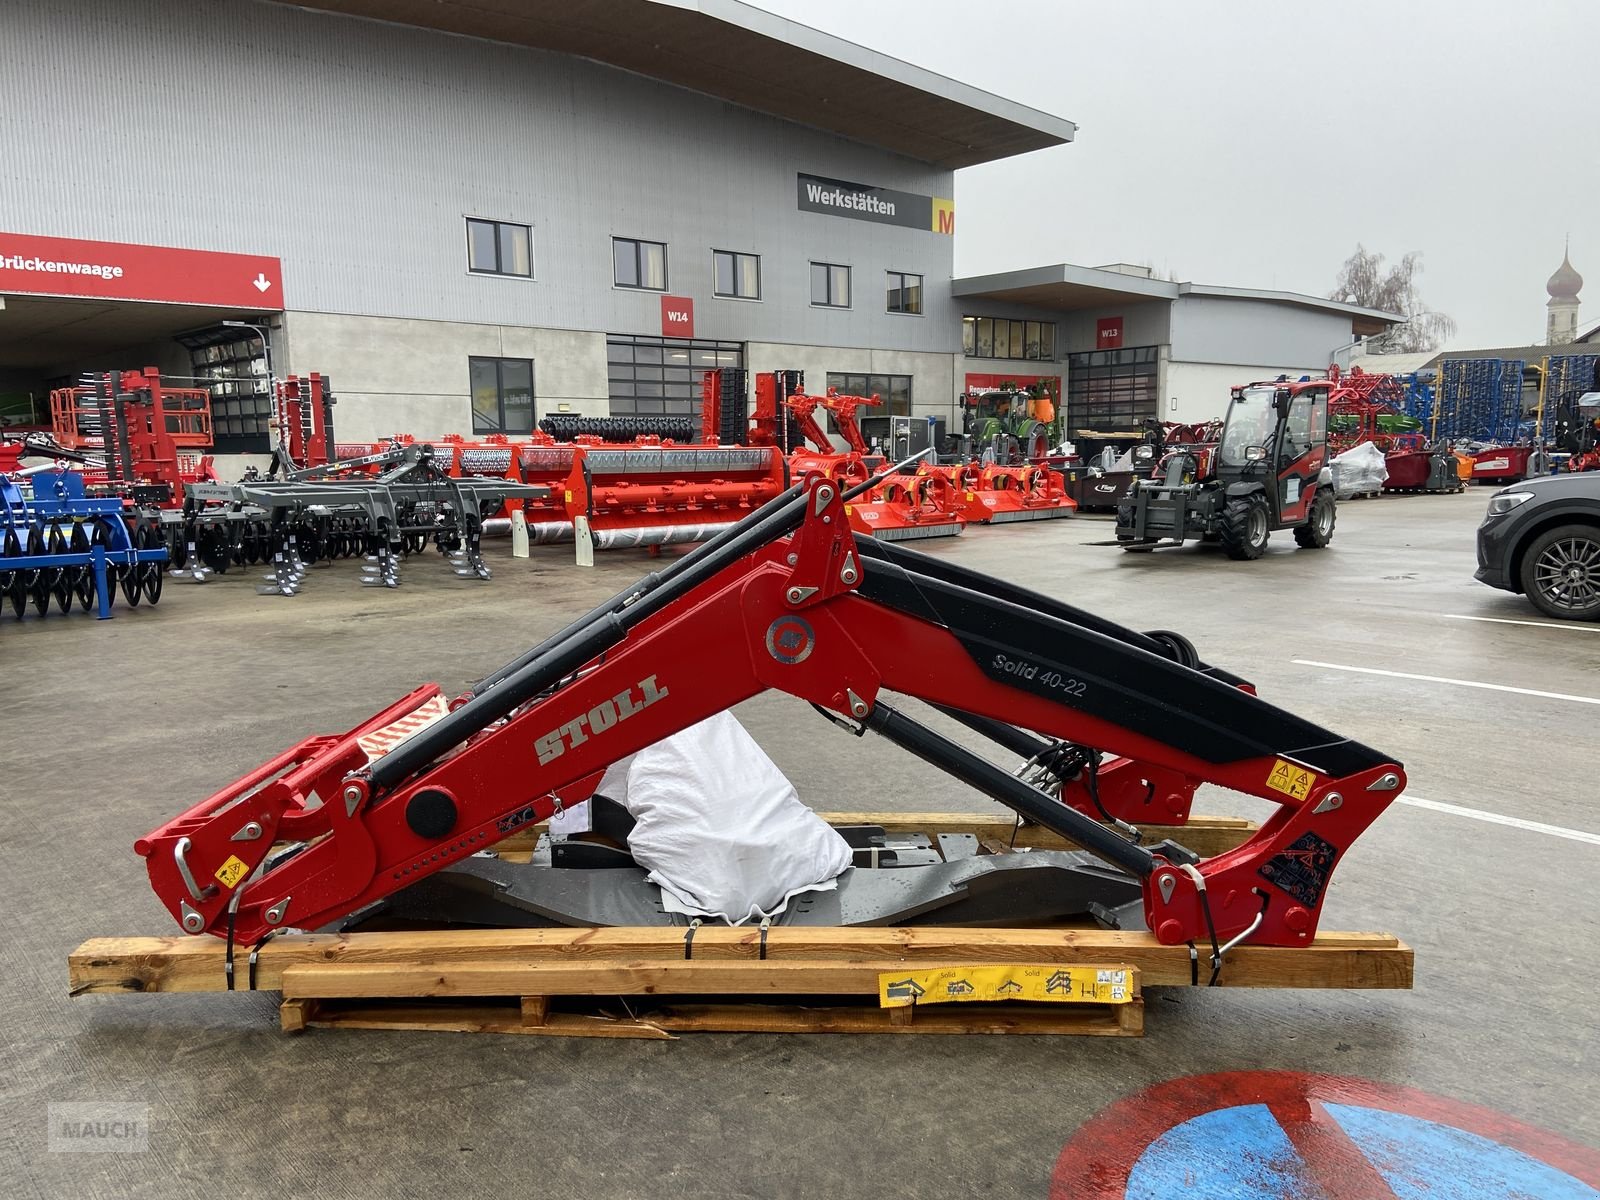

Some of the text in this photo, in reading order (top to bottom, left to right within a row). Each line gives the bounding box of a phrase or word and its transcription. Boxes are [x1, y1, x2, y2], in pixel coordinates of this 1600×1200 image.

[807, 184, 896, 216] Werkstätten
[667, 311, 689, 322] W14
[1101, 329, 1118, 338] W13
[992, 654, 1087, 697] Solid 40-22
[533, 674, 669, 766] STOLL
[1024, 969, 1040, 977] Solid
